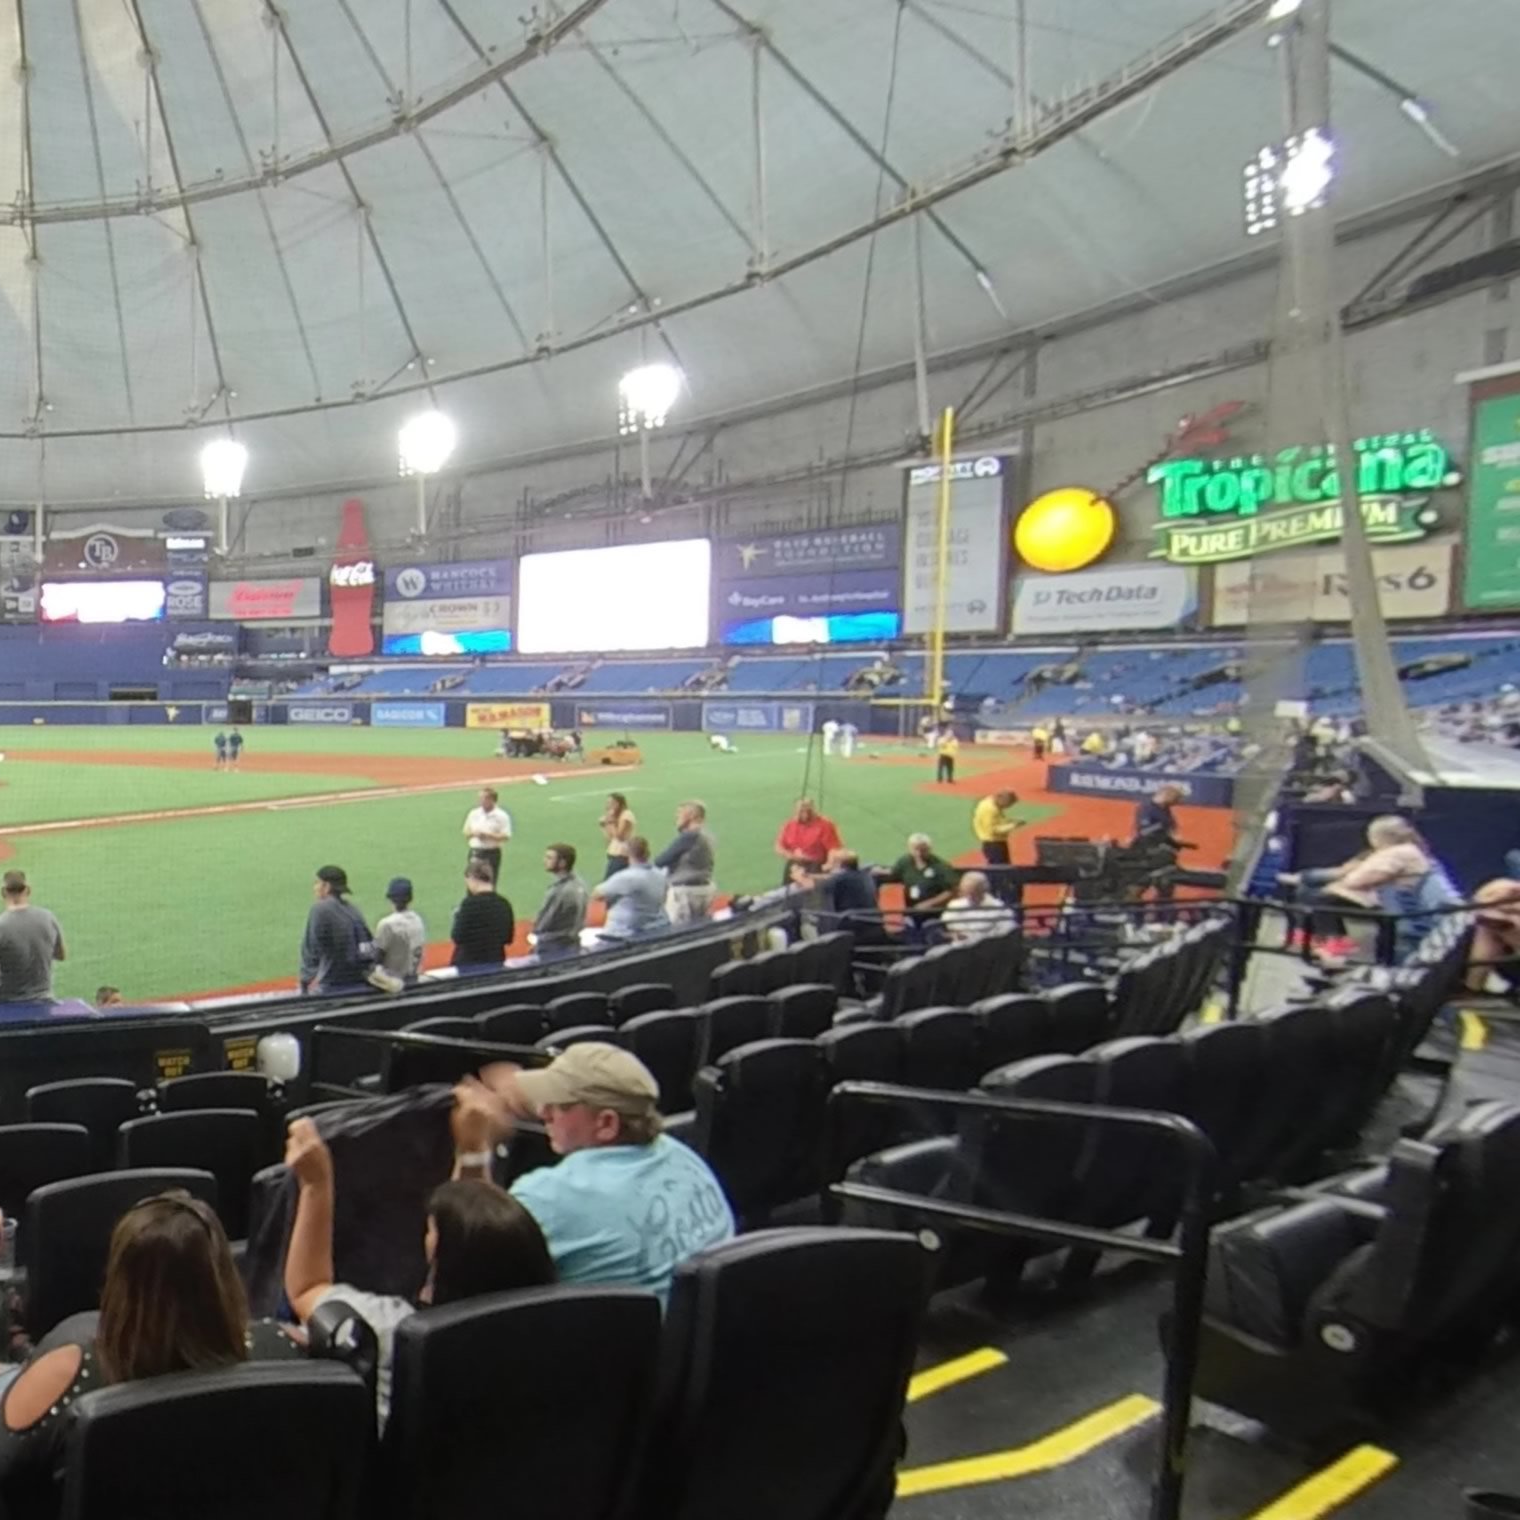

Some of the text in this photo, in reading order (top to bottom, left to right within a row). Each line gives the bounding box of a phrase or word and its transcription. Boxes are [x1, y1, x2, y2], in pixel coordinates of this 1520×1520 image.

[1171, 500, 1399, 557] PURE PREMIM
[429, 602, 479, 614] CROWN
[289, 707, 350, 722] GEICO
